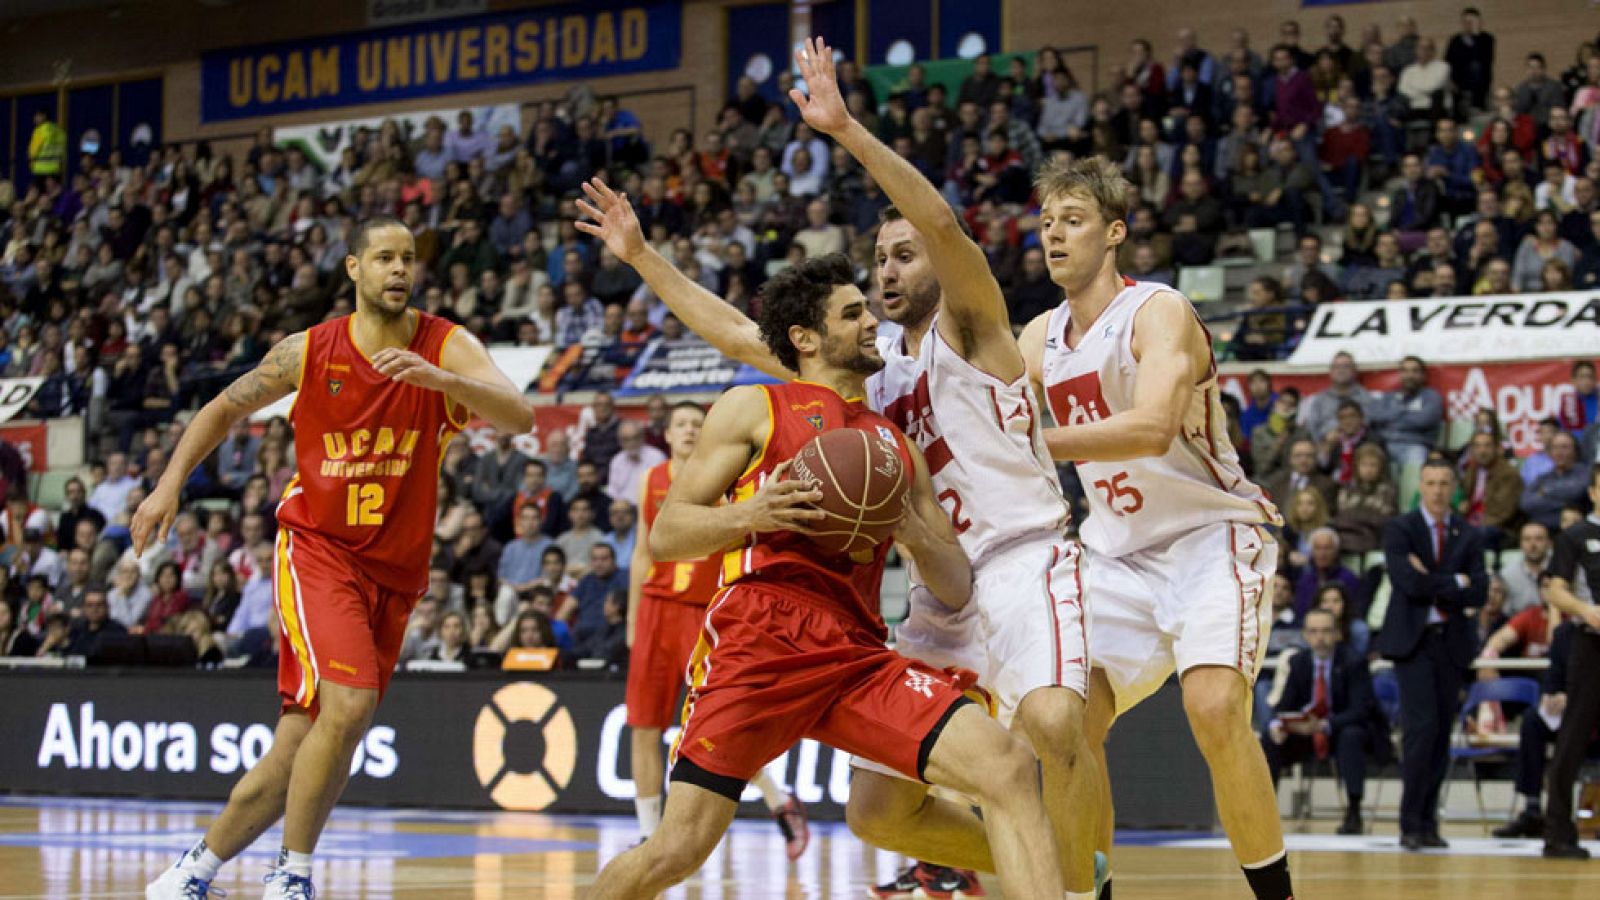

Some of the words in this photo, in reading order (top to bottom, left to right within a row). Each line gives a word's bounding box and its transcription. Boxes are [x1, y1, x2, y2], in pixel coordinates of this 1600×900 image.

[229, 45, 340, 107] UCAM
[357, 8, 648, 91] UNIVERSIDAD
[1315, 307, 1389, 339] LA
[346, 483, 385, 526] 12
[1093, 471, 1144, 516] 25
[37, 701, 198, 772] Ahora
[210, 721, 399, 778] sos
